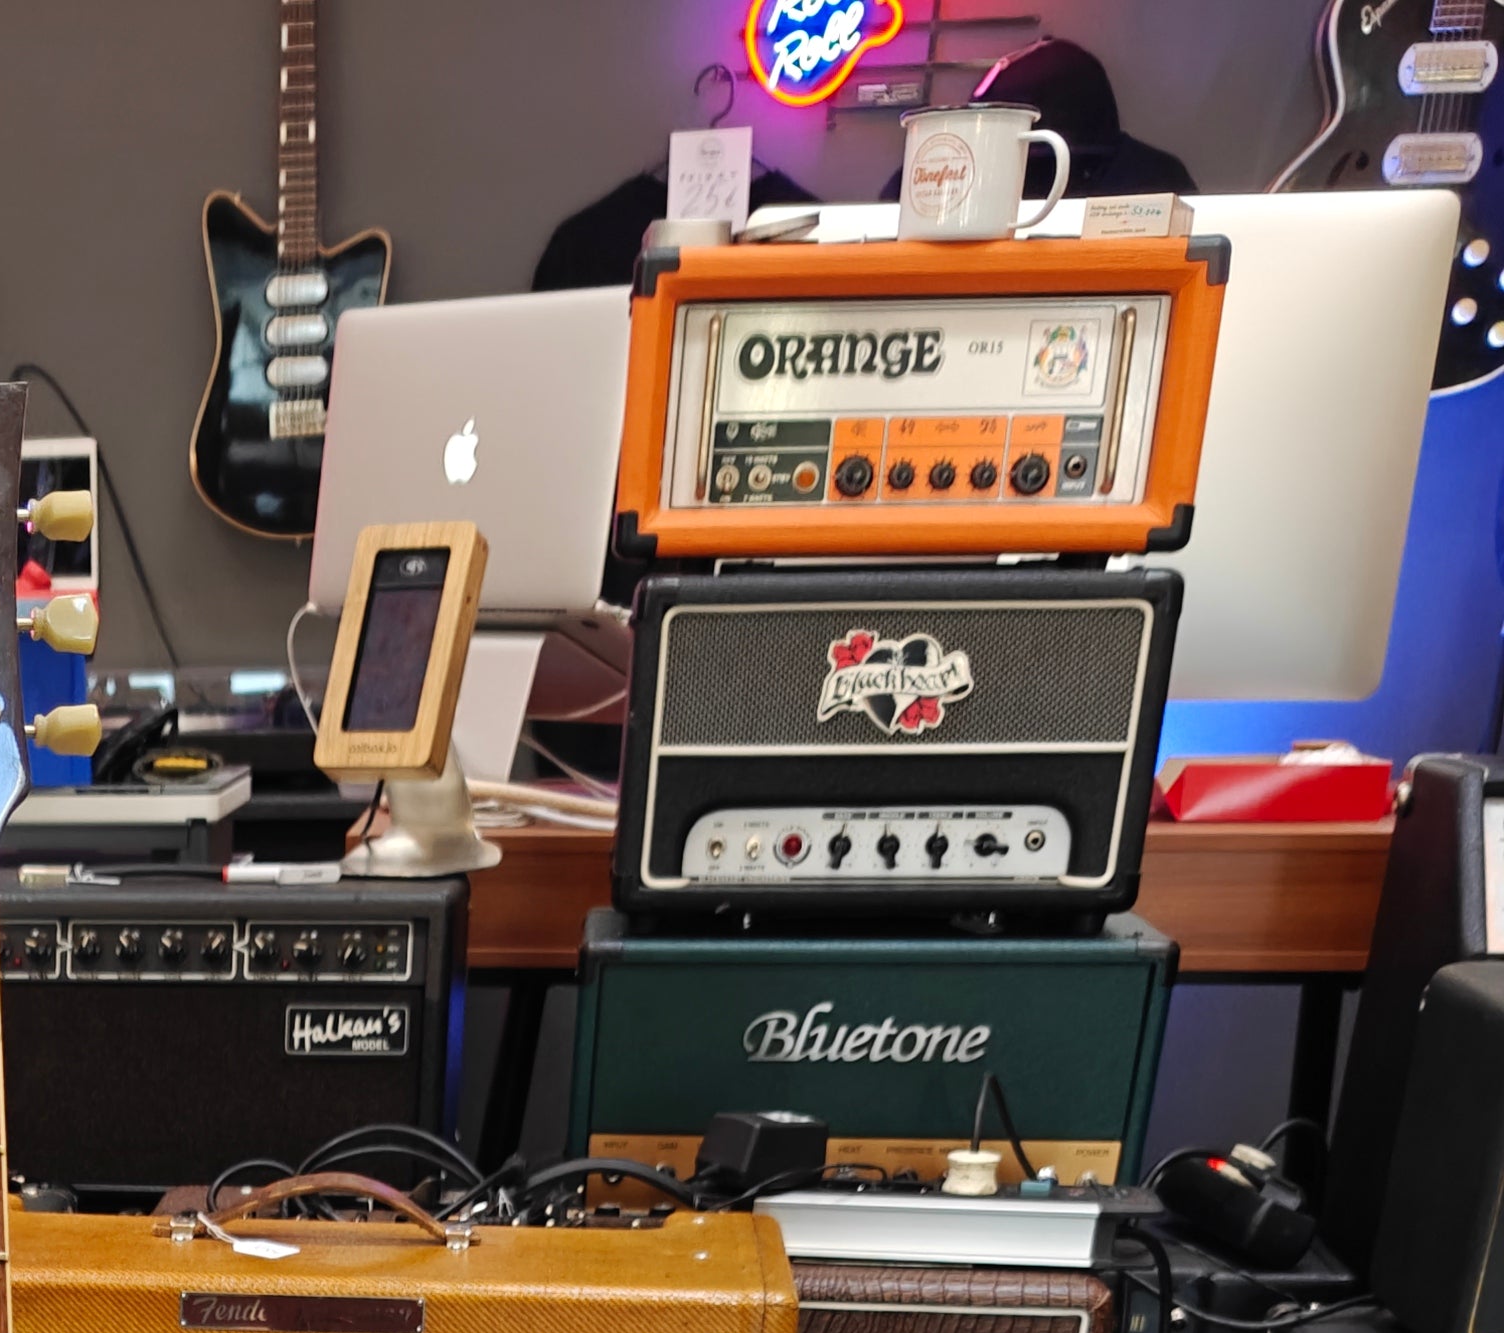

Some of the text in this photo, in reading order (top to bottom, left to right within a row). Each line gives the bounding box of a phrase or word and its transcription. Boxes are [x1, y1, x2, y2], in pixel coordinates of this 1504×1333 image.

[768, 1, 864, 90] Roll
[738, 329, 1004, 381] ORANGE OR15
[352, 1037, 389, 1051] MODEL
[743, 1002, 991, 1063] Bluetone
[193, 1296, 267, 1324] Fend
